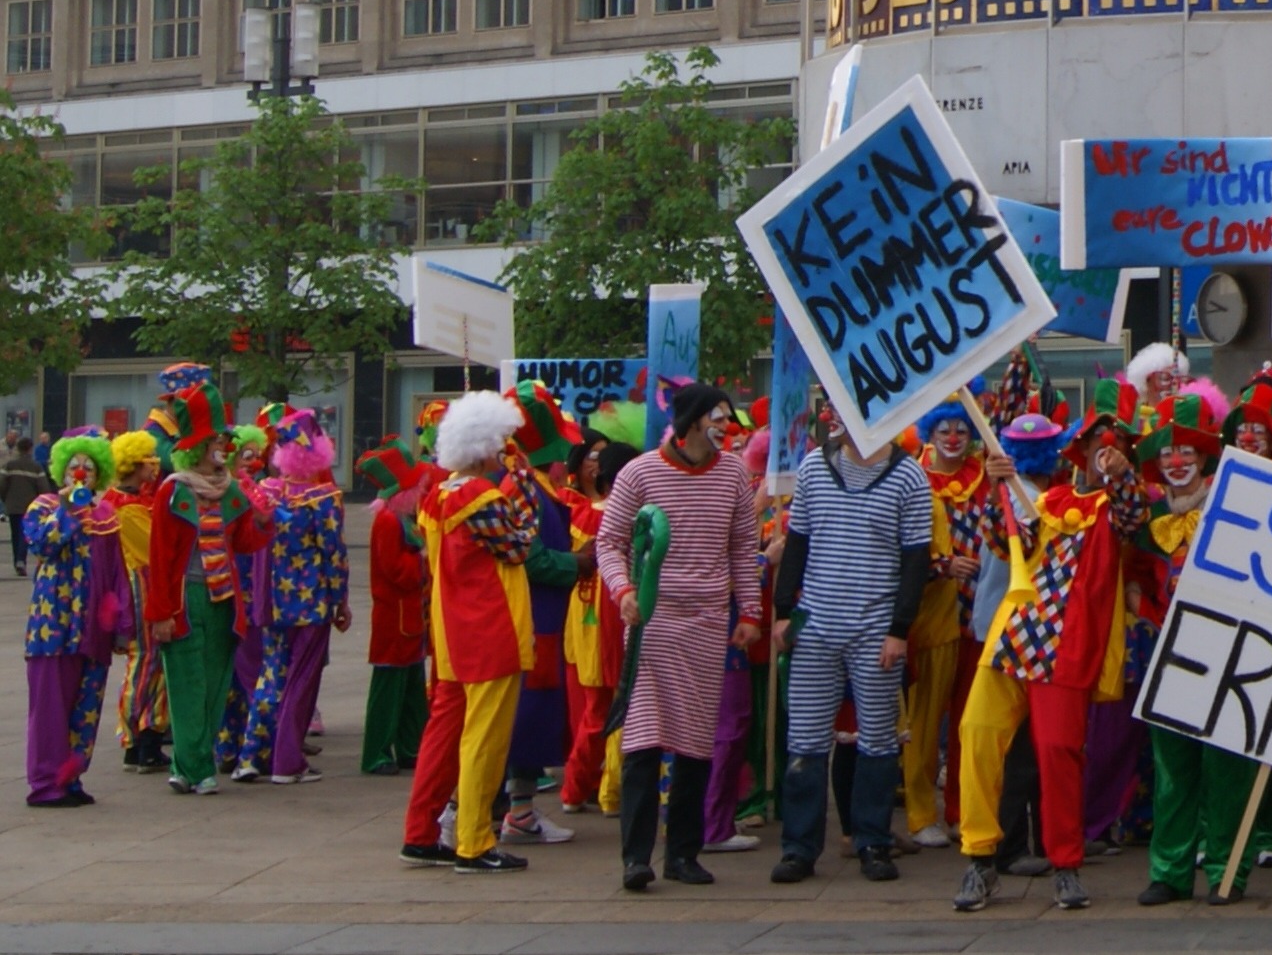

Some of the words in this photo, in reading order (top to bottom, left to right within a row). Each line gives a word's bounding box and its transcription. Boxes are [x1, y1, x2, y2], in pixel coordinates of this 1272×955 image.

[1002, 161, 1031, 175] APIA
[1160, 141, 1230, 175] sind
[806, 179, 999, 352] DUMMER
[847, 233, 1023, 421] AUGUST
[517, 360, 627, 389] HUMOR
